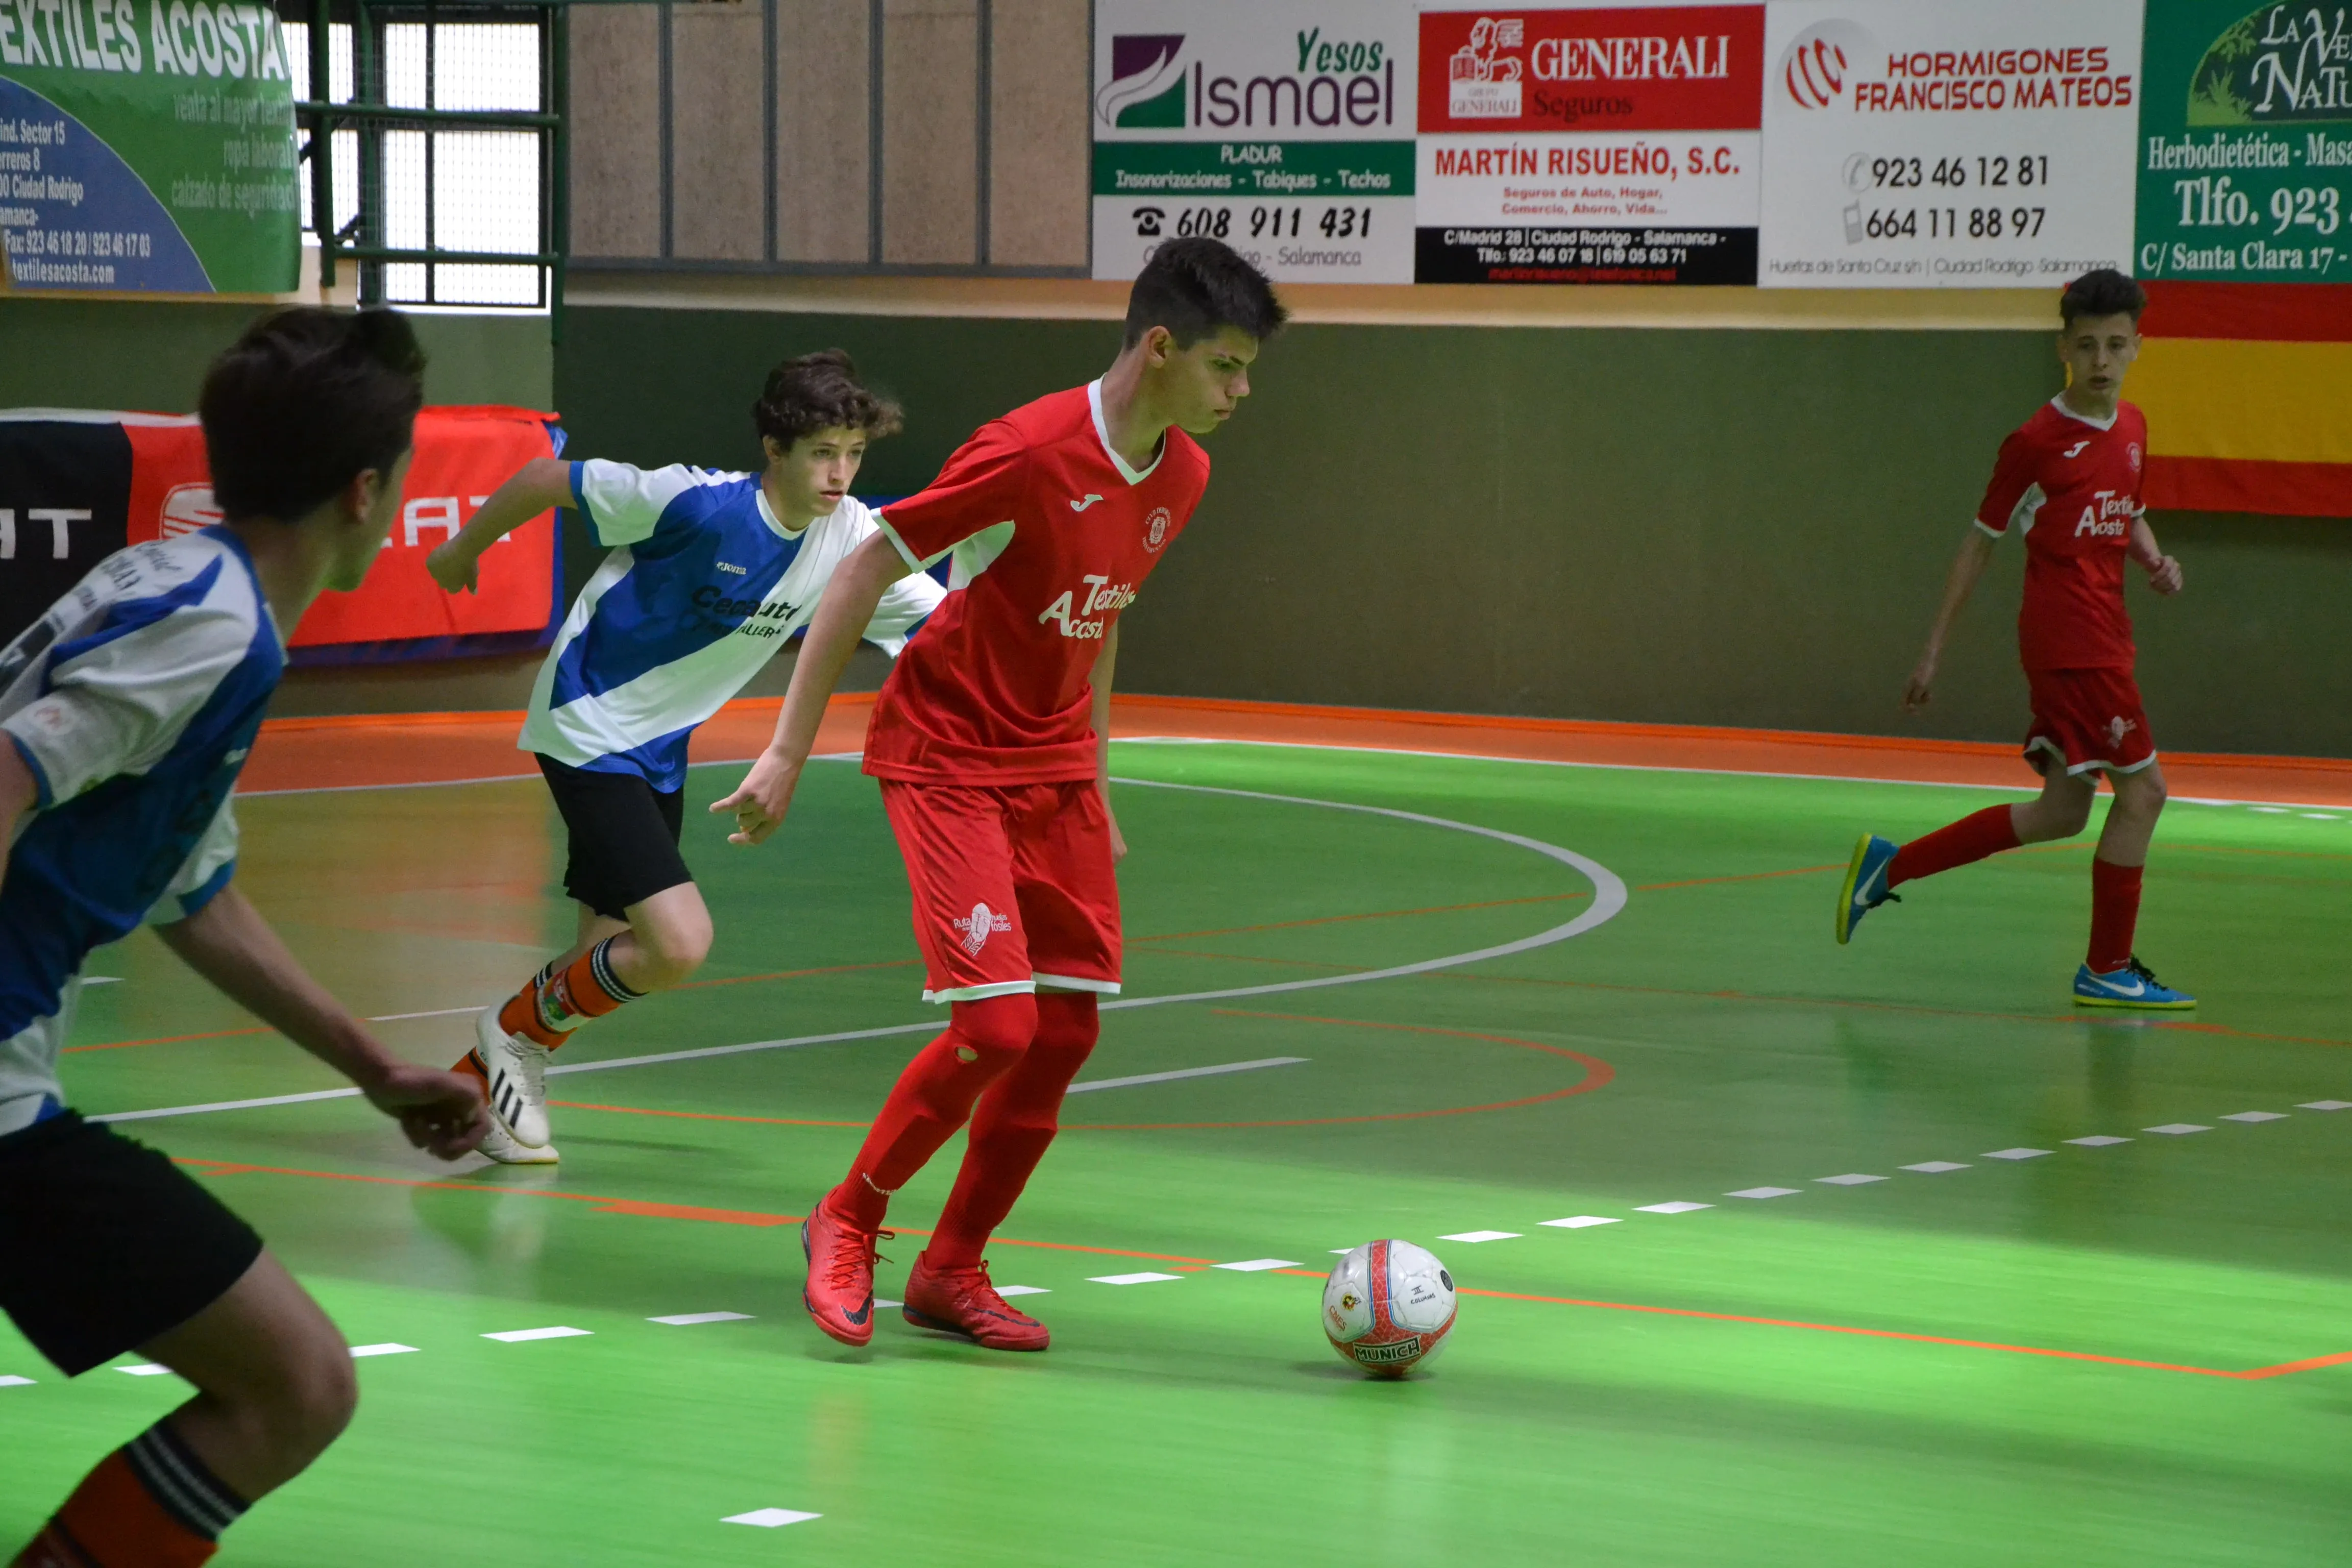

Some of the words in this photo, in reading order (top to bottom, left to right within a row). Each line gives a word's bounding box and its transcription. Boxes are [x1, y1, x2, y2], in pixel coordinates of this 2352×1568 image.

[152, 0, 285, 81] ACOSTA
[1296, 27, 1384, 73] Yesos
[1531, 36, 1729, 80] GENERALI
[1889, 47, 2108, 78] HORMIGONES
[1194, 58, 1393, 127] Ismael
[1533, 90, 1633, 123] Seguros
[1855, 79, 2005, 112] FRANCISCO
[2014, 76, 2132, 108] MATEOS
[20, 118, 51, 145] Sector
[54, 120, 65, 145] 15
[33, 146, 40, 172] 8
[1220, 145, 1282, 163] PLADUR
[1435, 143, 1537, 176] MARTÍN
[1548, 142, 1678, 181] RISUEÑO,
[1687, 147, 1740, 175] S.C.
[2148, 131, 2289, 169] Herbodietética
[1115, 169, 1232, 189] Insonorizaciones
[1252, 169, 1317, 192] Tabiques
[1338, 169, 1391, 188] Techos
[1872, 158, 1922, 187] 923
[1932, 158, 1965, 186] 46
[1978, 157, 2008, 186] 12
[2017, 156, 2047, 185] 81
[12, 173, 45, 200] Ciudad
[48, 175, 83, 205] Rodrigo
[1504, 187, 1557, 200] Seguros
[1560, 187, 1577, 198] de
[1581, 187, 1615, 199] Auto,
[1620, 186, 1663, 200] Hogar,
[2175, 176, 2259, 226] Tlfo.
[2271, 187, 2339, 236] 923
[1177, 206, 1232, 238] 608
[1251, 206, 1302, 238] 911
[1319, 206, 1371, 238] 431
[1867, 209, 1917, 238] 664
[1929, 208, 1954, 237] 11
[1969, 208, 2002, 237] 88
[2012, 208, 2045, 237] 97
[27, 230, 44, 254] 923
[47, 230, 59, 255] 46
[61, 231, 72, 255] 18
[113, 232, 124, 256] 46
[126, 232, 137, 256] 17
[139, 233, 150, 257] 03
[1505, 230, 1523, 246] 28
[1532, 230, 1578, 246] Ciudad
[1580, 230, 1632, 248] Rodrigo
[1644, 230, 1717, 246] Salamanca
[12, 257, 114, 283] textilesacosta.com
[1278, 245, 1362, 265] Salamanca
[1509, 247, 1534, 263] 923
[1537, 247, 1556, 263] 46
[1558, 247, 1576, 263] 07
[1628, 248, 1647, 264] 05
[1649, 248, 1668, 264] 63
[1671, 248, 1687, 264] 71
[1934, 258, 1982, 274] Ciudad
[1984, 258, 2034, 277] Rodrigo
[2172, 243, 2235, 271] Santa
[2242, 240, 2302, 271] Clara
[2310, 248, 2334, 275] 17
[1354, 1340, 1420, 1360] MUNICH
